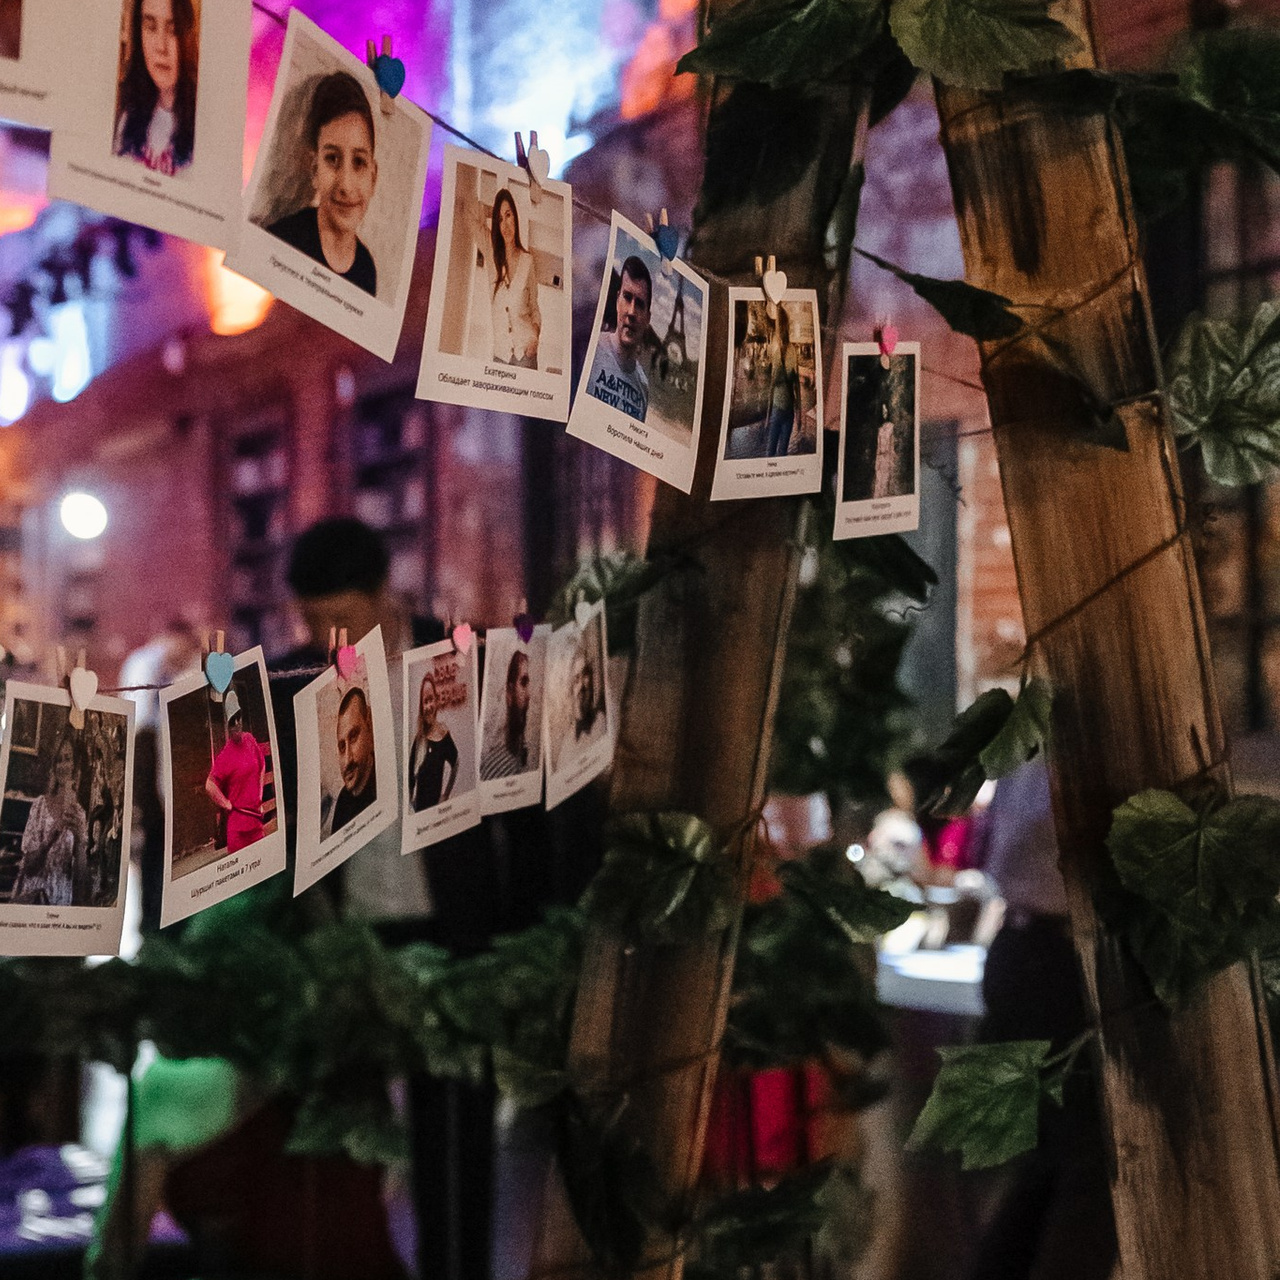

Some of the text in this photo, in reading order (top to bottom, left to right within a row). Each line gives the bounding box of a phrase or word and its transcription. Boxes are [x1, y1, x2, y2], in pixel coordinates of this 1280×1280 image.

[484, 365, 517, 381] Екатерина
[437, 372, 554, 401] Обладает завораживающим голосом
[593, 386, 620, 408] NEW
[606, 424, 633, 445] Воротила
[633, 440, 651, 454] наших
[629, 422, 649, 439] Никита
[216, 857, 239, 874] Наталья
[190, 880, 214, 899] Шуршит
[215, 869, 240, 887] пакетами
